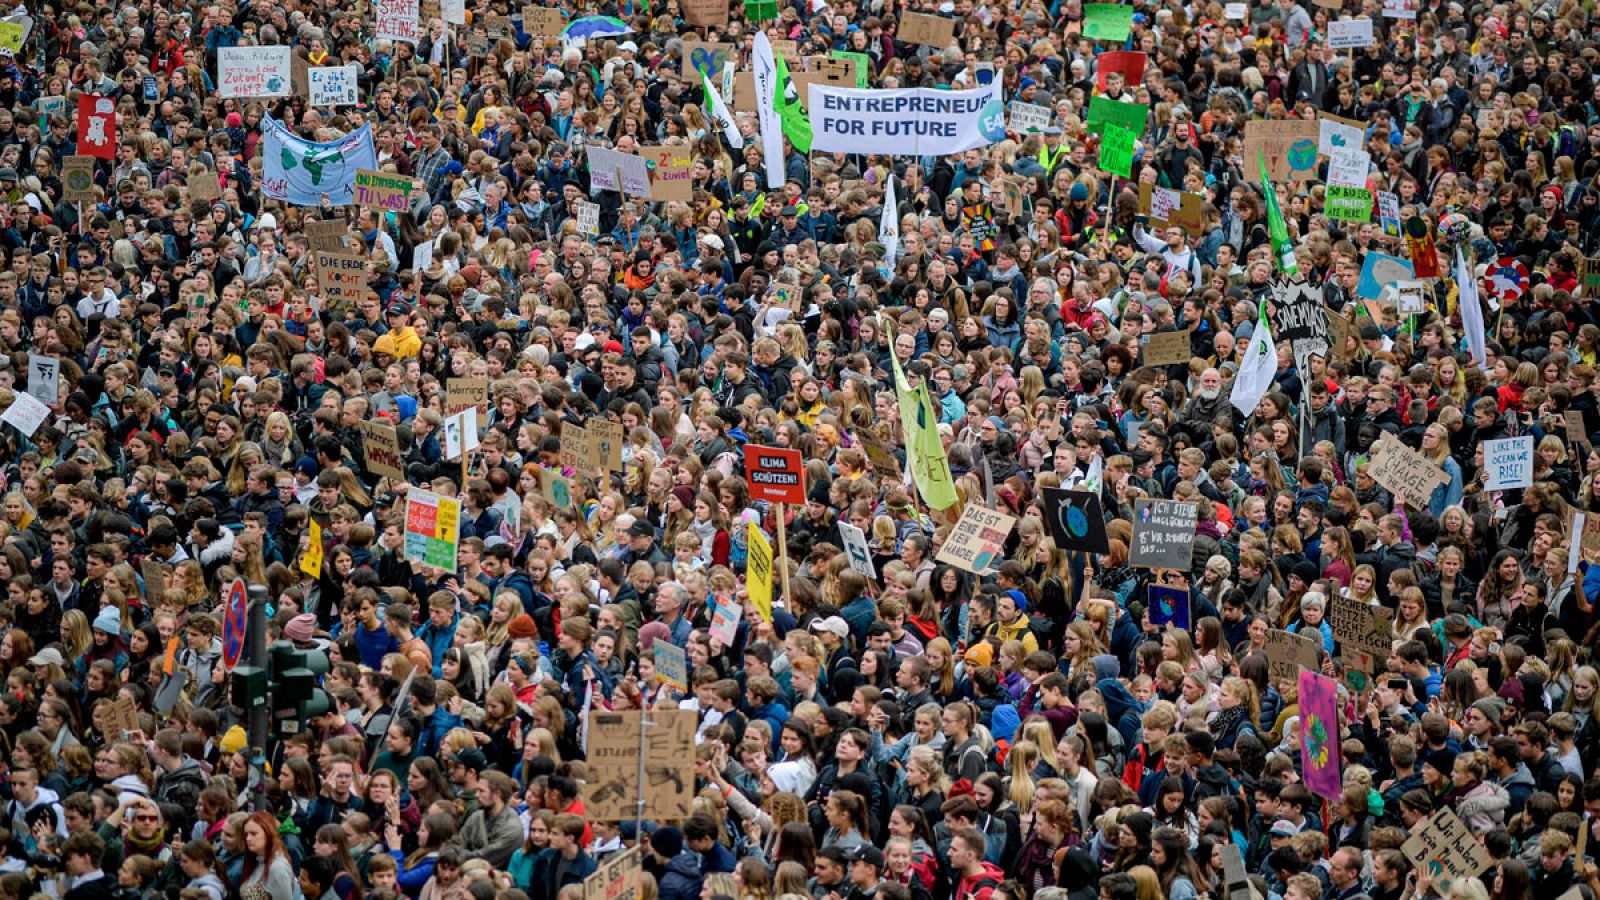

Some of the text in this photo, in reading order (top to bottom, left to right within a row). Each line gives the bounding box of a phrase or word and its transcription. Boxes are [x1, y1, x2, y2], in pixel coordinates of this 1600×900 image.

[381, 0, 413, 16] START
[377, 18, 416, 37] ACTING
[314, 88, 356, 104] Planet B
[823, 117, 957, 137] FOR FUTURE
[357, 186, 409, 212] TU WAS!
[320, 256, 365, 270] DIE ERDE
[325, 286, 362, 299] VOR WUT
[1492, 439, 1526, 454] LIKE THE
[760, 456, 787, 469] KLIMA
[1386, 441, 1436, 479] WE HAVE TO
[1491, 450, 1529, 465] OCEAN WE
[752, 471, 797, 484] SCHÜTZEN!
[1384, 455, 1427, 493] CHANGE
[1499, 463, 1525, 480] RISE!
[1153, 501, 1170, 515] ICH
[965, 507, 1001, 527] DAS IST
[1358, 634, 1392, 650] FISCHE
[1420, 826, 1437, 851] kein
[1433, 811, 1479, 871] Wir haben
[1415, 847, 1429, 863] B
